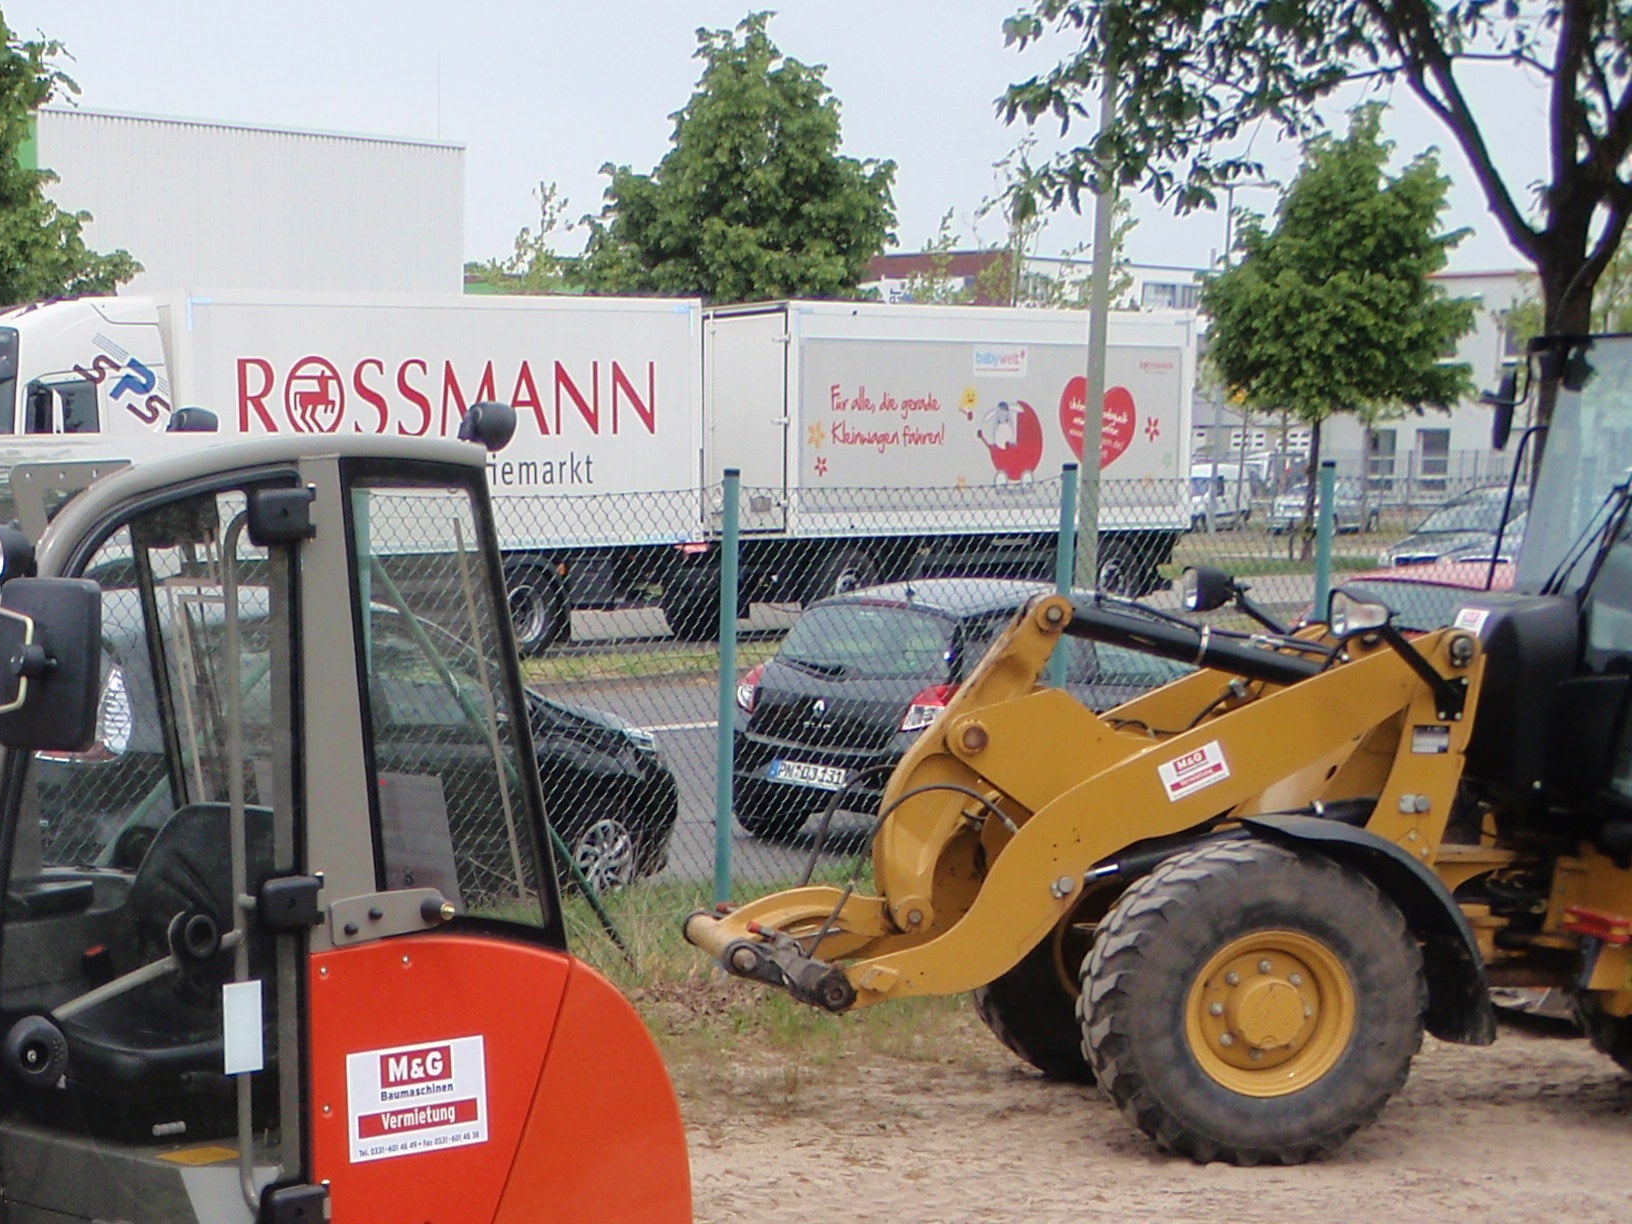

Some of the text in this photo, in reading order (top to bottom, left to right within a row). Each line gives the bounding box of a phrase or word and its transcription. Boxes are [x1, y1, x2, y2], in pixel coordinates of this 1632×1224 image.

[73, 354, 172, 425] SPS
[236, 355, 655, 437] ROSSMANN
[830, 384, 941, 420] Für alle, die gerade
[831, 420, 945, 454] Kleinwagen fahren!
[388, 1051, 444, 1082] M&G
[380, 1083, 454, 1101] Baumaschinen
[381, 1105, 456, 1130] Vermietung
